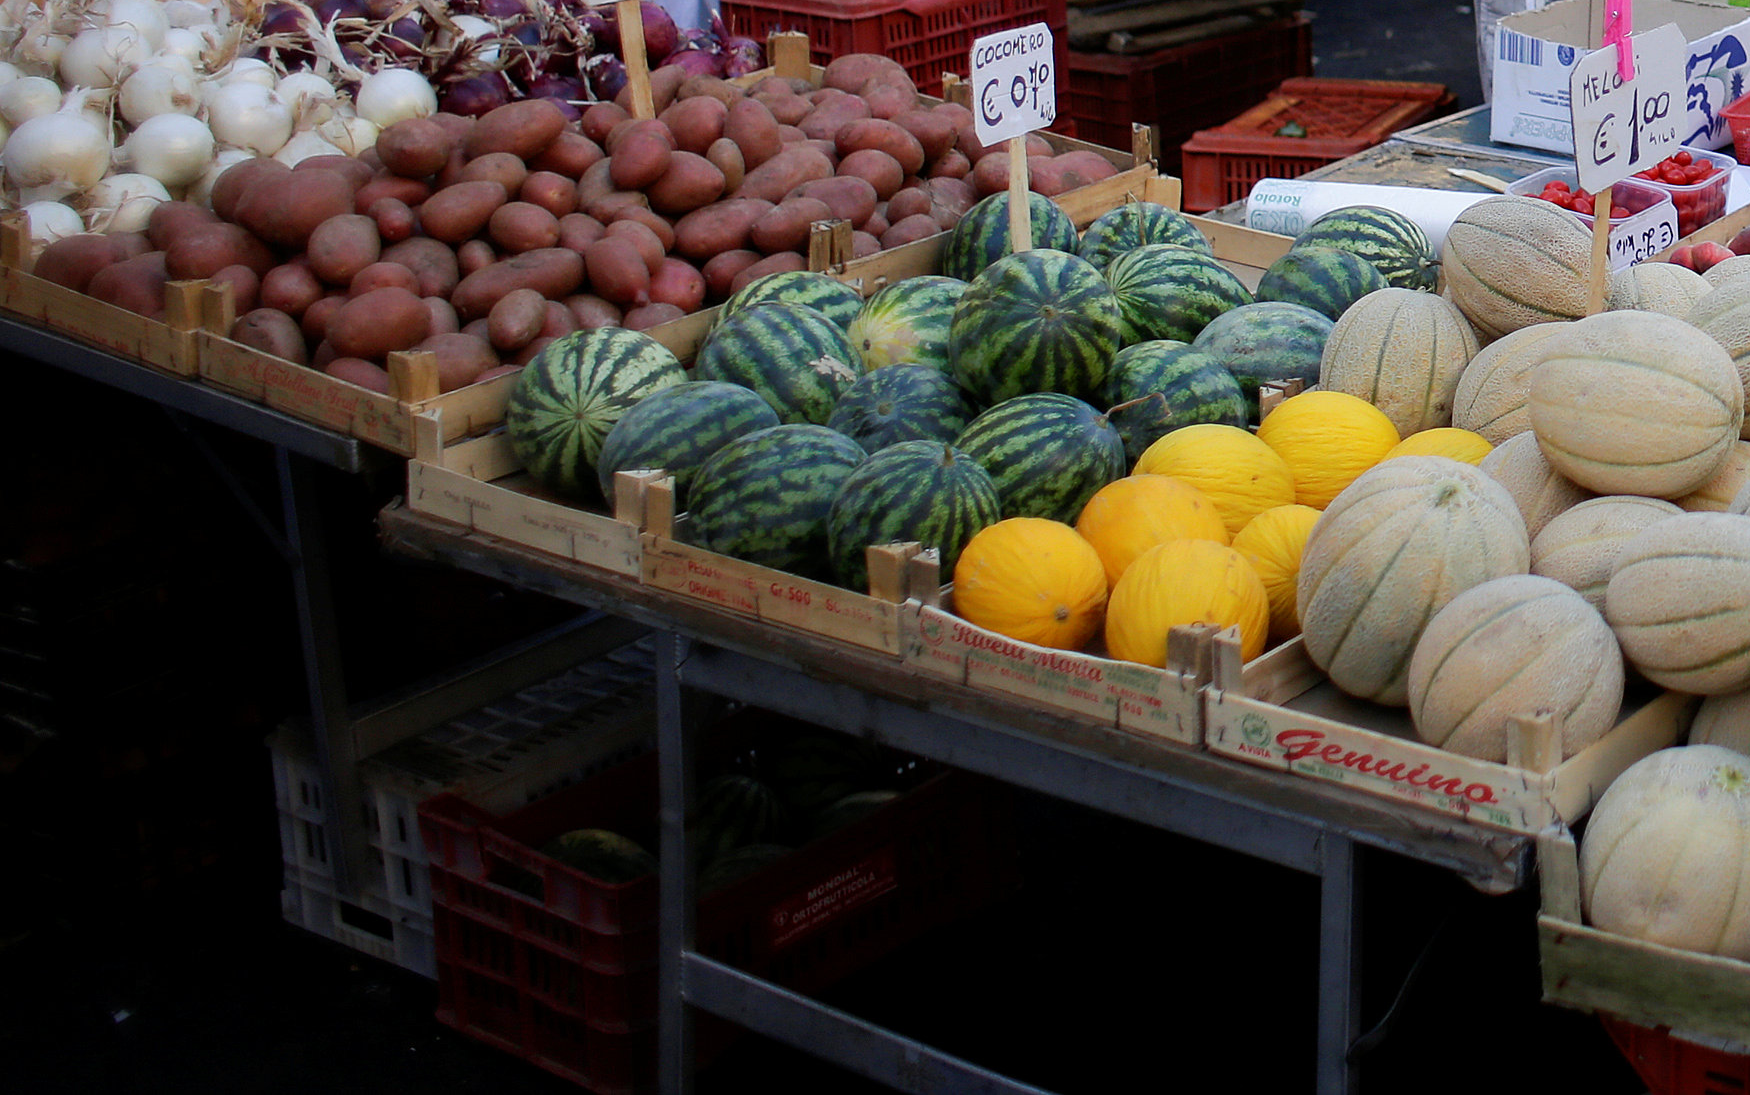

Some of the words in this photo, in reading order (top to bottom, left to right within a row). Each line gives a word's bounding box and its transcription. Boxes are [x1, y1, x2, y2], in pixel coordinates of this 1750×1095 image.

[1254, 192, 1302, 207] Rotolo
[1031, 649, 1104, 685] Maria
[1275, 728, 1499, 805] Genuino
[792, 871, 876, 924] ORTOFRUTTICOLA
[807, 866, 860, 902] MONDIAL
